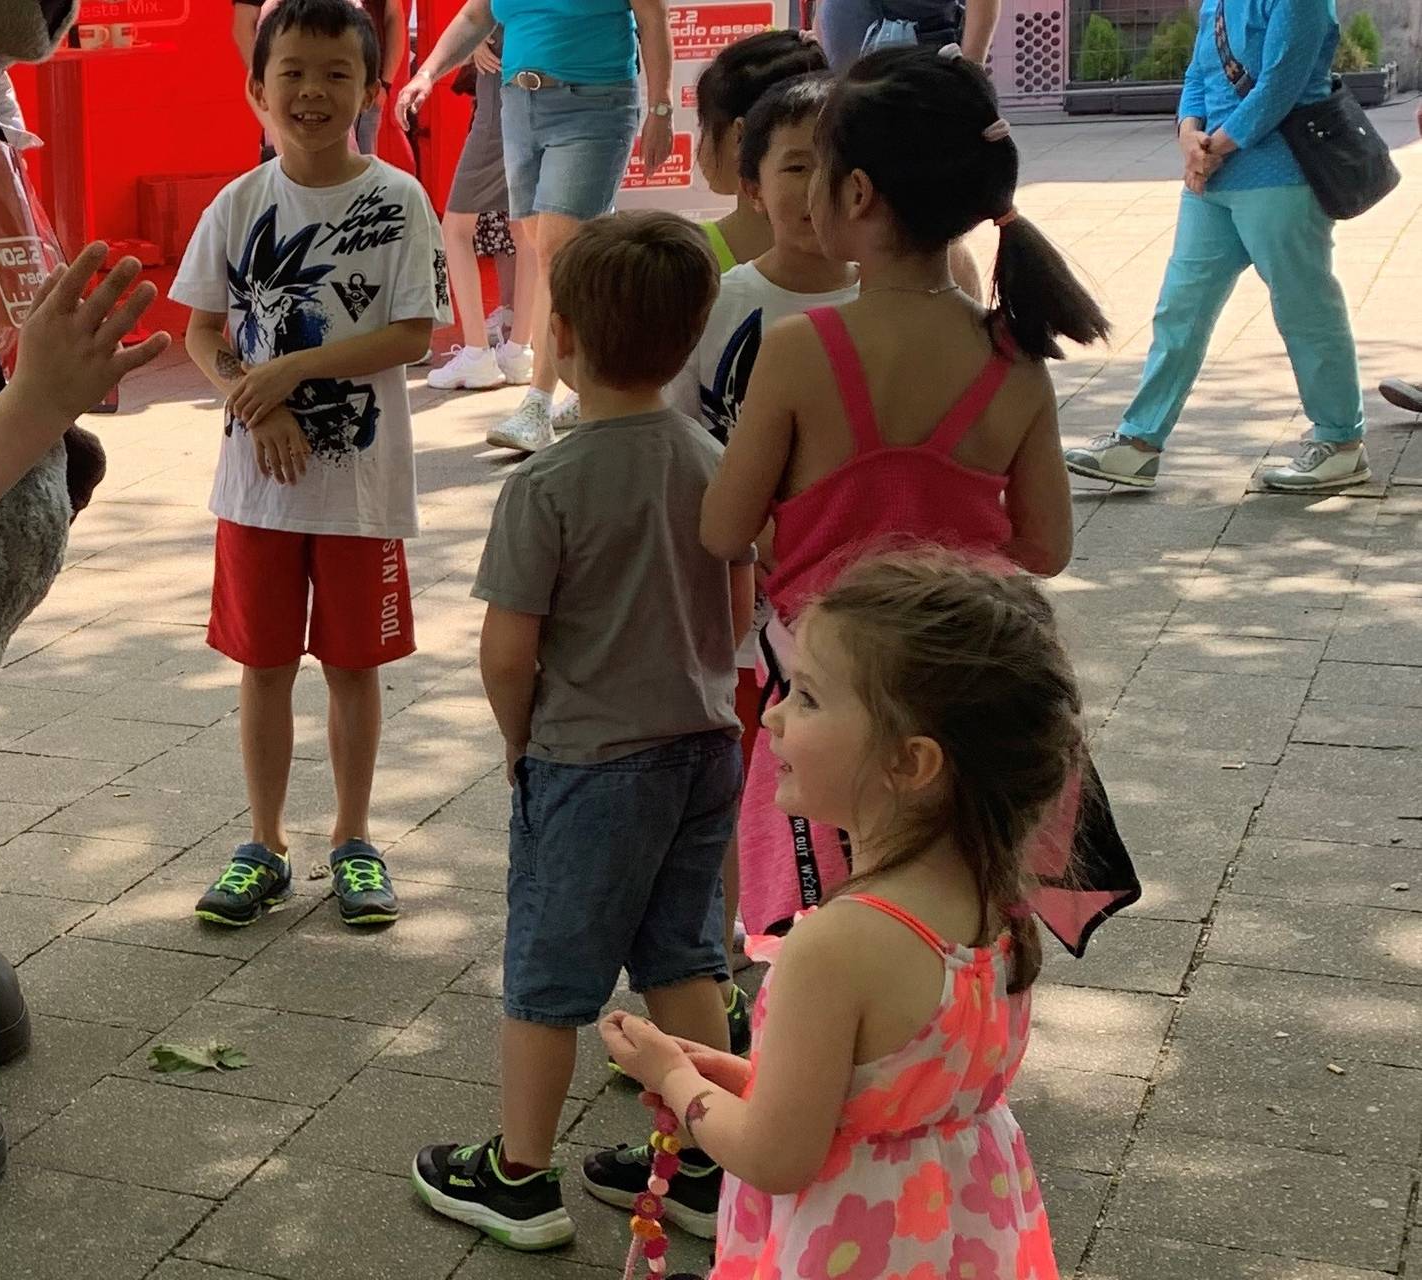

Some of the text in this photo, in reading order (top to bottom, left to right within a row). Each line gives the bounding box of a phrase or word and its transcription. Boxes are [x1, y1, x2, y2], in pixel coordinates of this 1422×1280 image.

[81, 3, 119, 18] este
[668, 10, 698, 24] 2.2
[670, 25, 707, 36] adio
[314, 204, 405, 249] YOUR
[331, 225, 405, 256] MOVE
[381, 538, 402, 646] STAY COOL
